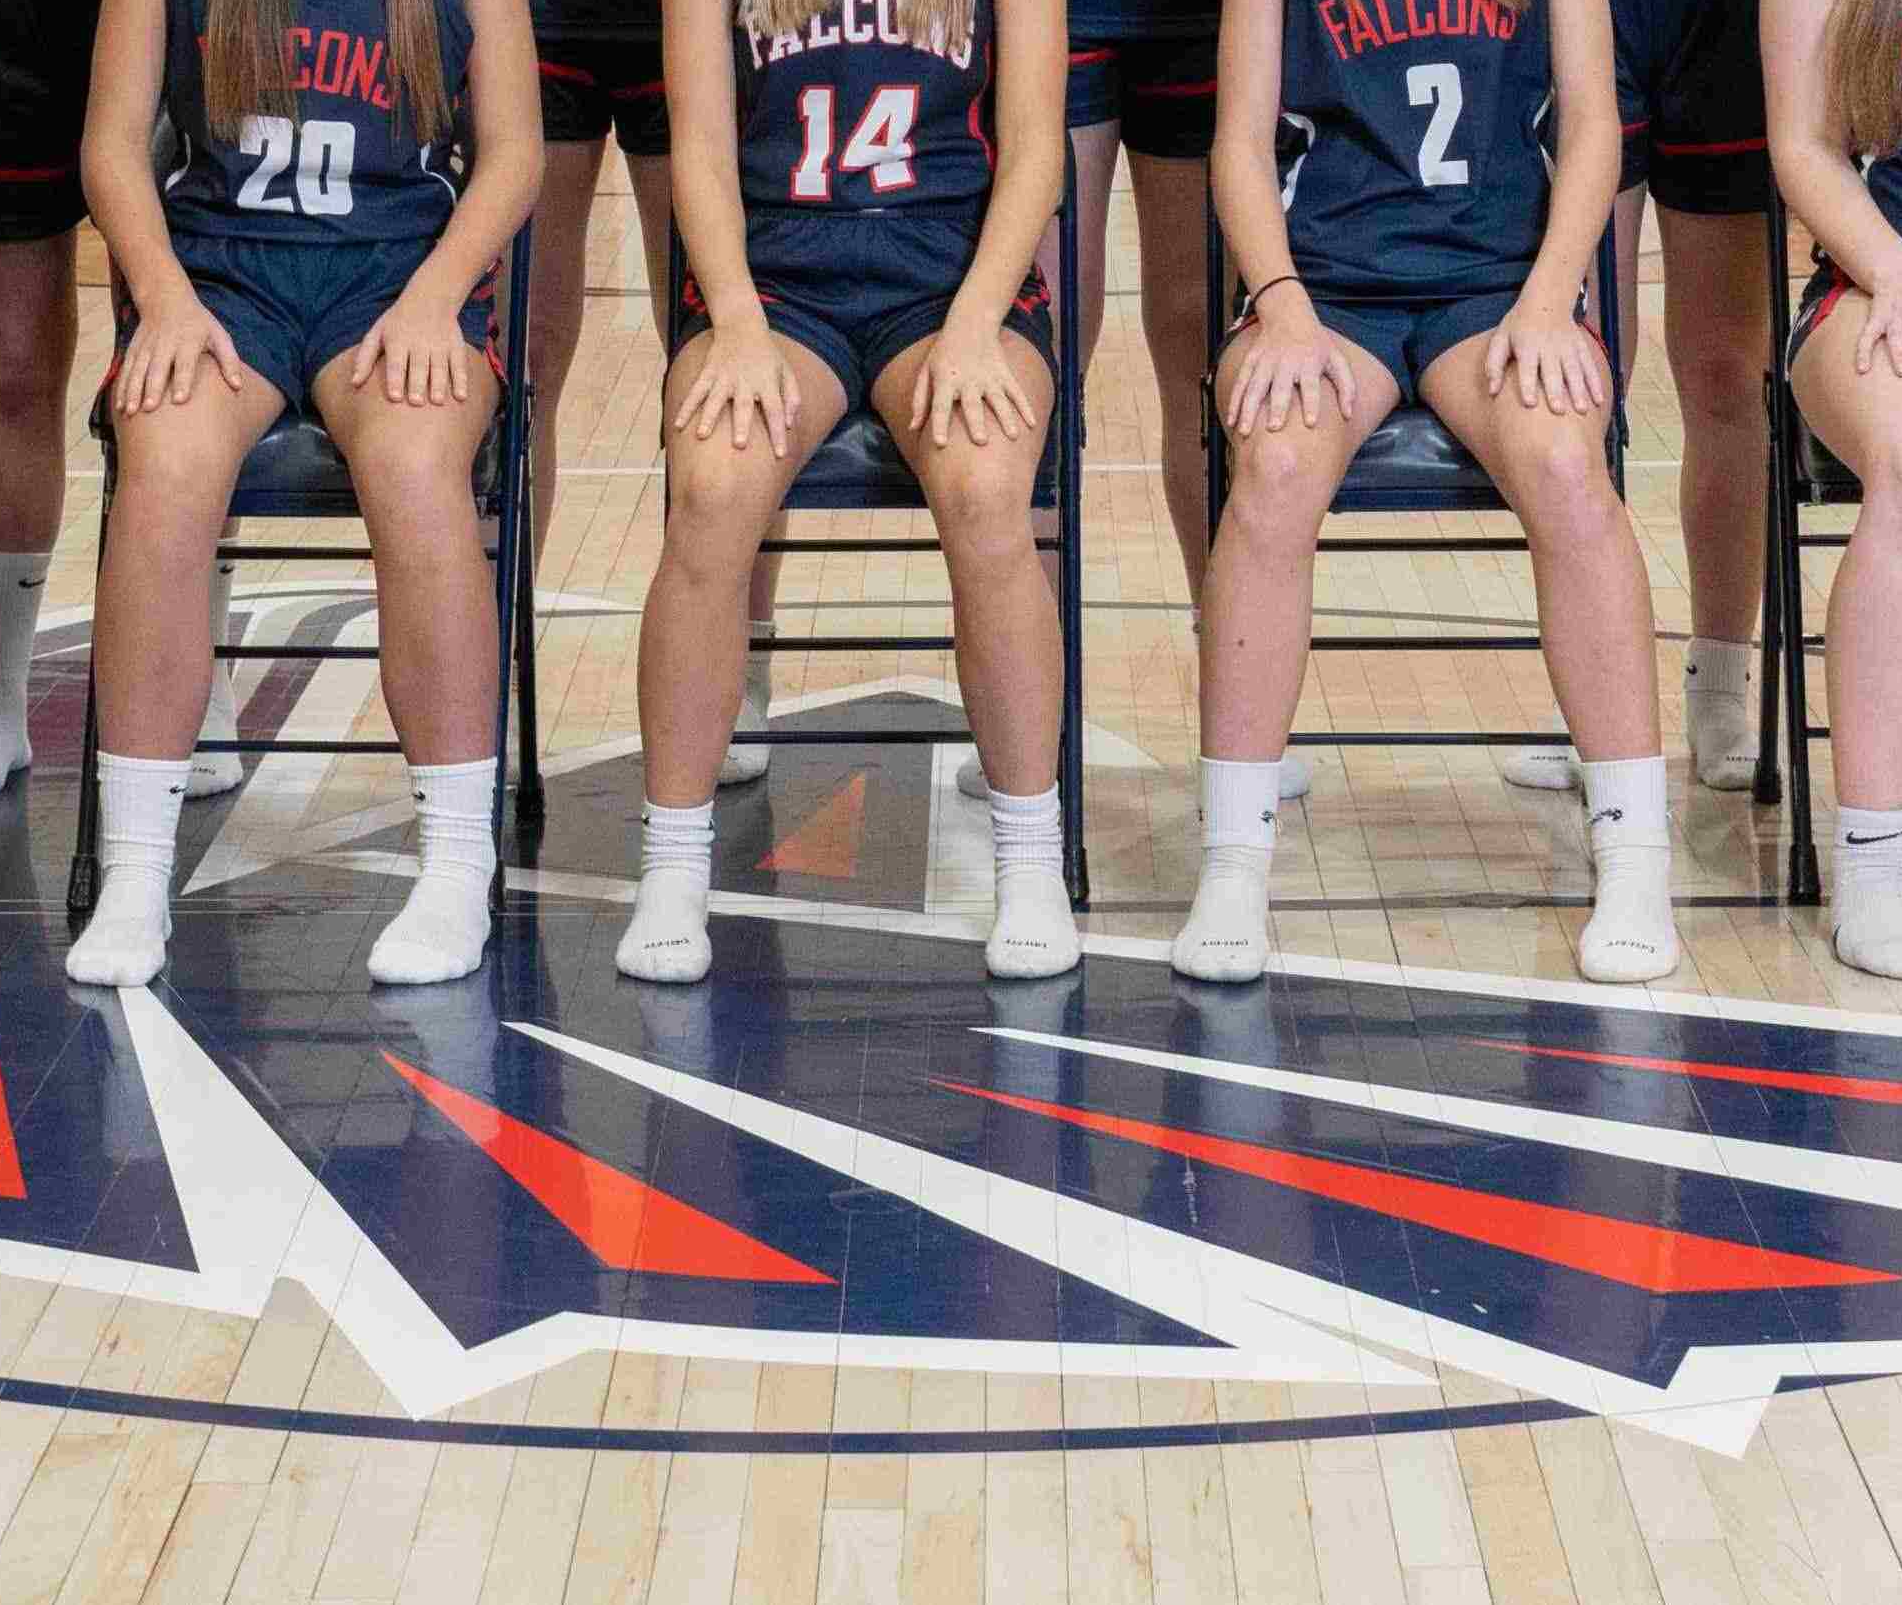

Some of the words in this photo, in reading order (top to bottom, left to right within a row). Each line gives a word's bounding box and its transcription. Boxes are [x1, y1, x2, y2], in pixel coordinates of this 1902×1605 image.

[236, 114, 356, 215] 20
[790, 84, 920, 202] 14
[1406, 63, 1469, 187] 2
